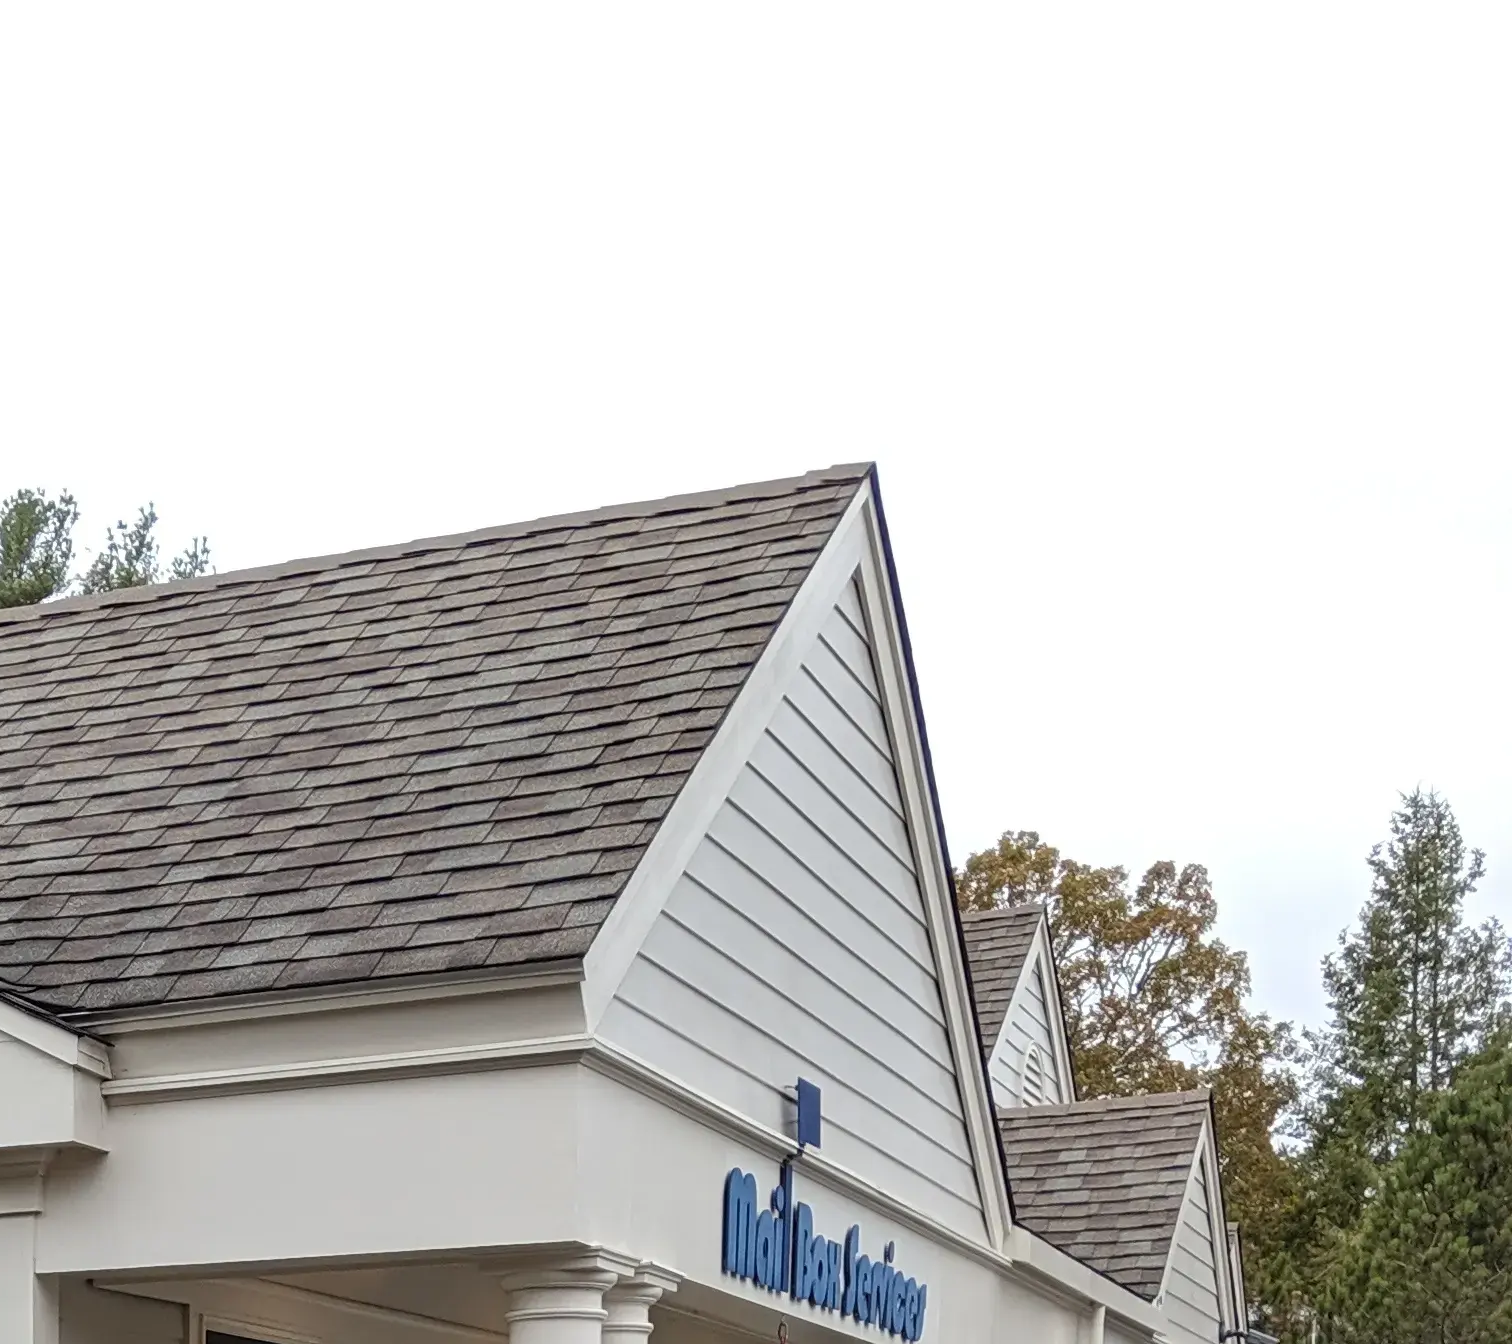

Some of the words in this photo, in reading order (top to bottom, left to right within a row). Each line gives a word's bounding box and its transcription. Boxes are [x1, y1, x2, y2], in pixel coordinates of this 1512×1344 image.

[722, 1163, 792, 1294] Mail
[792, 1201, 842, 1311] Box
[841, 1223, 928, 1342] Services
